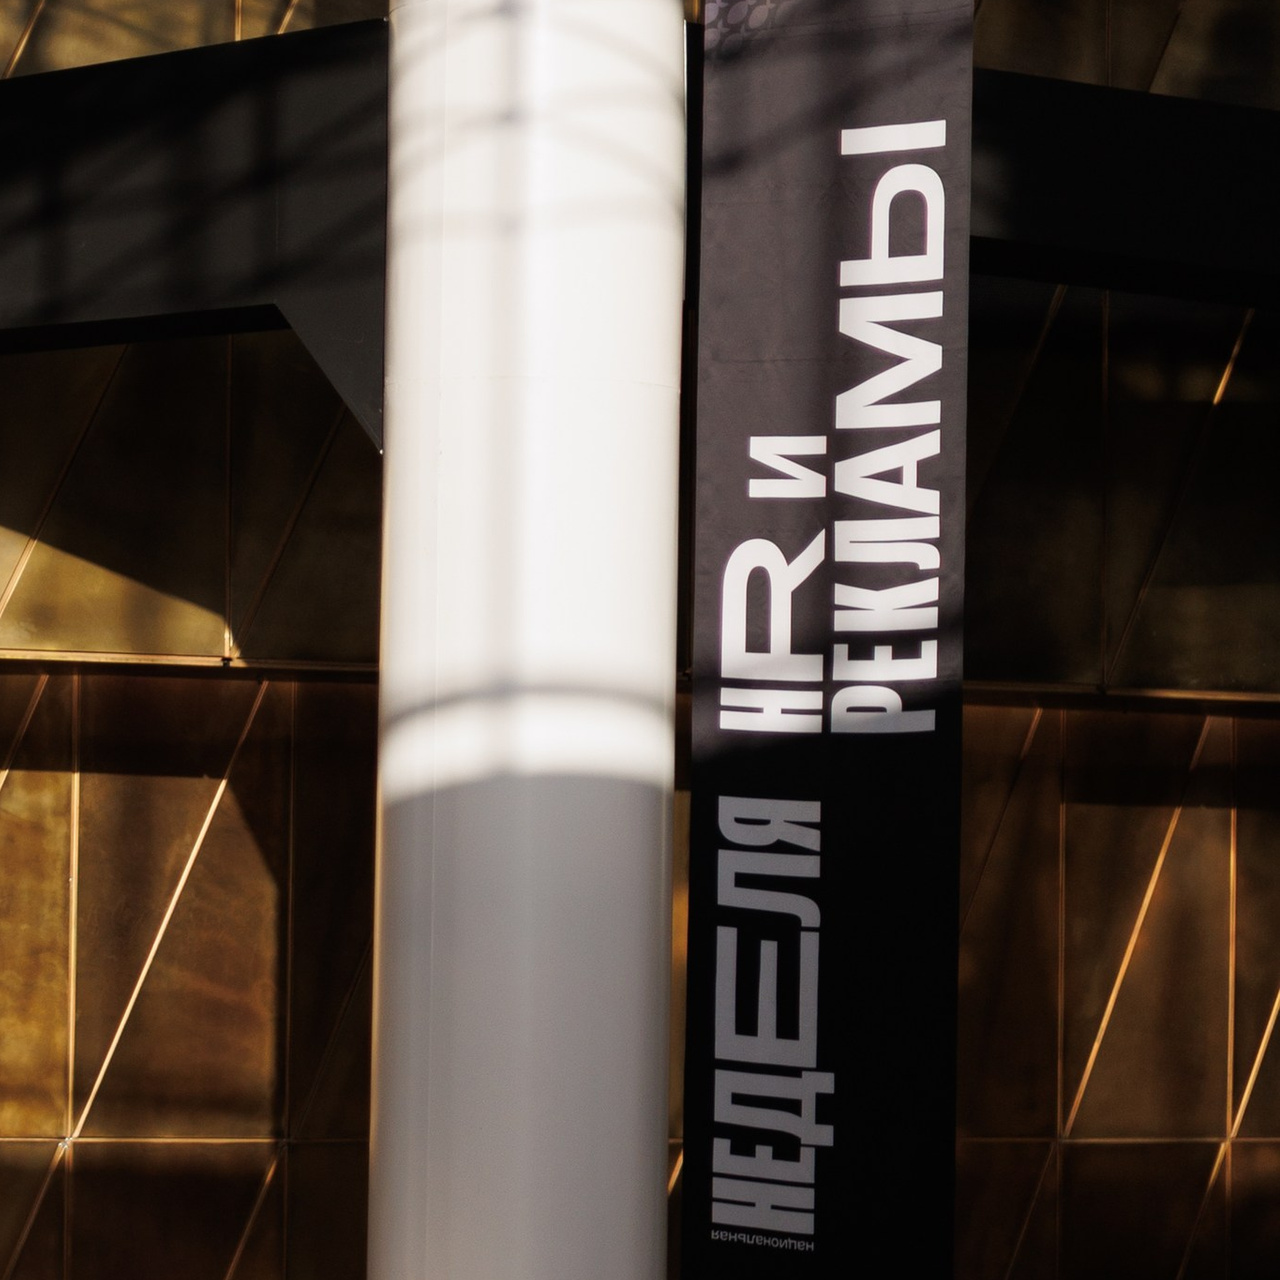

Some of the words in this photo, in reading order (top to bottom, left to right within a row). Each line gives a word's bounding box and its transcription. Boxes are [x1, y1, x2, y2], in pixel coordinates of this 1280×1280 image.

[747, 434, 828, 499] И
[829, 118, 948, 734] РЕКЛАМЫ
[718, 528, 827, 734] HR
[710, 794, 836, 1236] НЕДЕЛЯ
[710, 1228, 816, 1253] национальная
